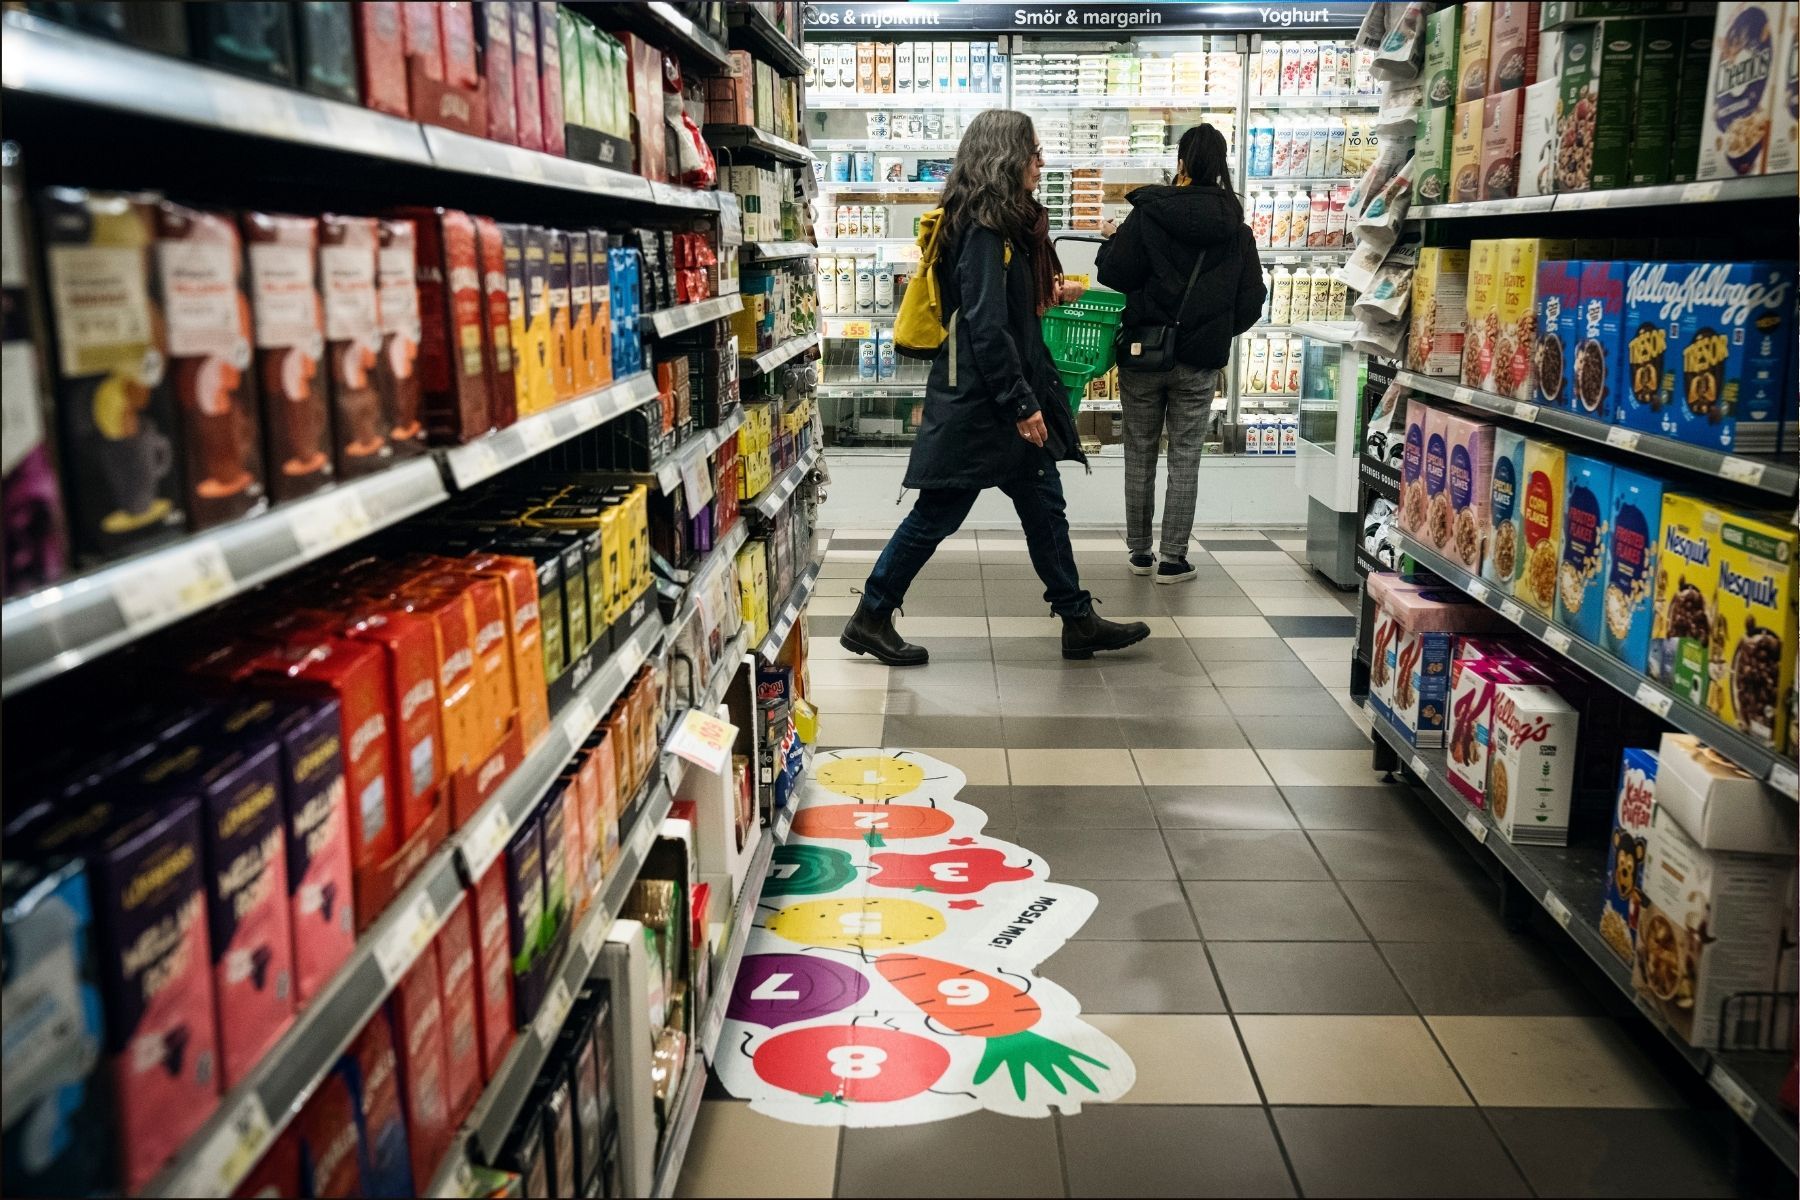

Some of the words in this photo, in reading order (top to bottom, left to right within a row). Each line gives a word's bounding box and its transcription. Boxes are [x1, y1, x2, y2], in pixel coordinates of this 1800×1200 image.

[843, 9, 856, 24] &
[1014, 9, 1062, 24] Smör
[1066, 10, 1079, 24] &
[1083, 10, 1162, 28] margarin
[1258, 7, 1329, 26] Yoghurt
[1348, 137, 1362, 146] YO
[1366, 137, 1379, 146] YO
[1503, 272, 1526, 289] Havre
[1505, 291, 1520, 306] fras
[1681, 263, 1791, 325] Kellogg's
[1063, 308, 1085, 318] coop
[1361, 463, 1380, 480] SVERIGES
[1493, 491, 1511, 506] FLAKES
[1529, 495, 1548, 513] CORN
[1526, 508, 1549, 528] FLAKES
[1568, 507, 1597, 529] FROSTED
[1570, 522, 1593, 543] FLAKES
[1616, 525, 1645, 550] FROSTED
[1616, 542, 1640, 565] FLAKES
[1665, 524, 1711, 568] Nesquik
[1719, 559, 1779, 610] Nesquik
[863, 770, 888, 784] 1
[852, 811, 889, 829] 2
[765, 864, 801, 879] 4
[929, 862, 969, 882] 3
[1012, 896, 1058, 925] MOSA
[838, 911, 883, 935] 5
[987, 925, 1027, 949] MIG!
[750, 972, 800, 1000] 7
[826, 1045, 888, 1079] 8
